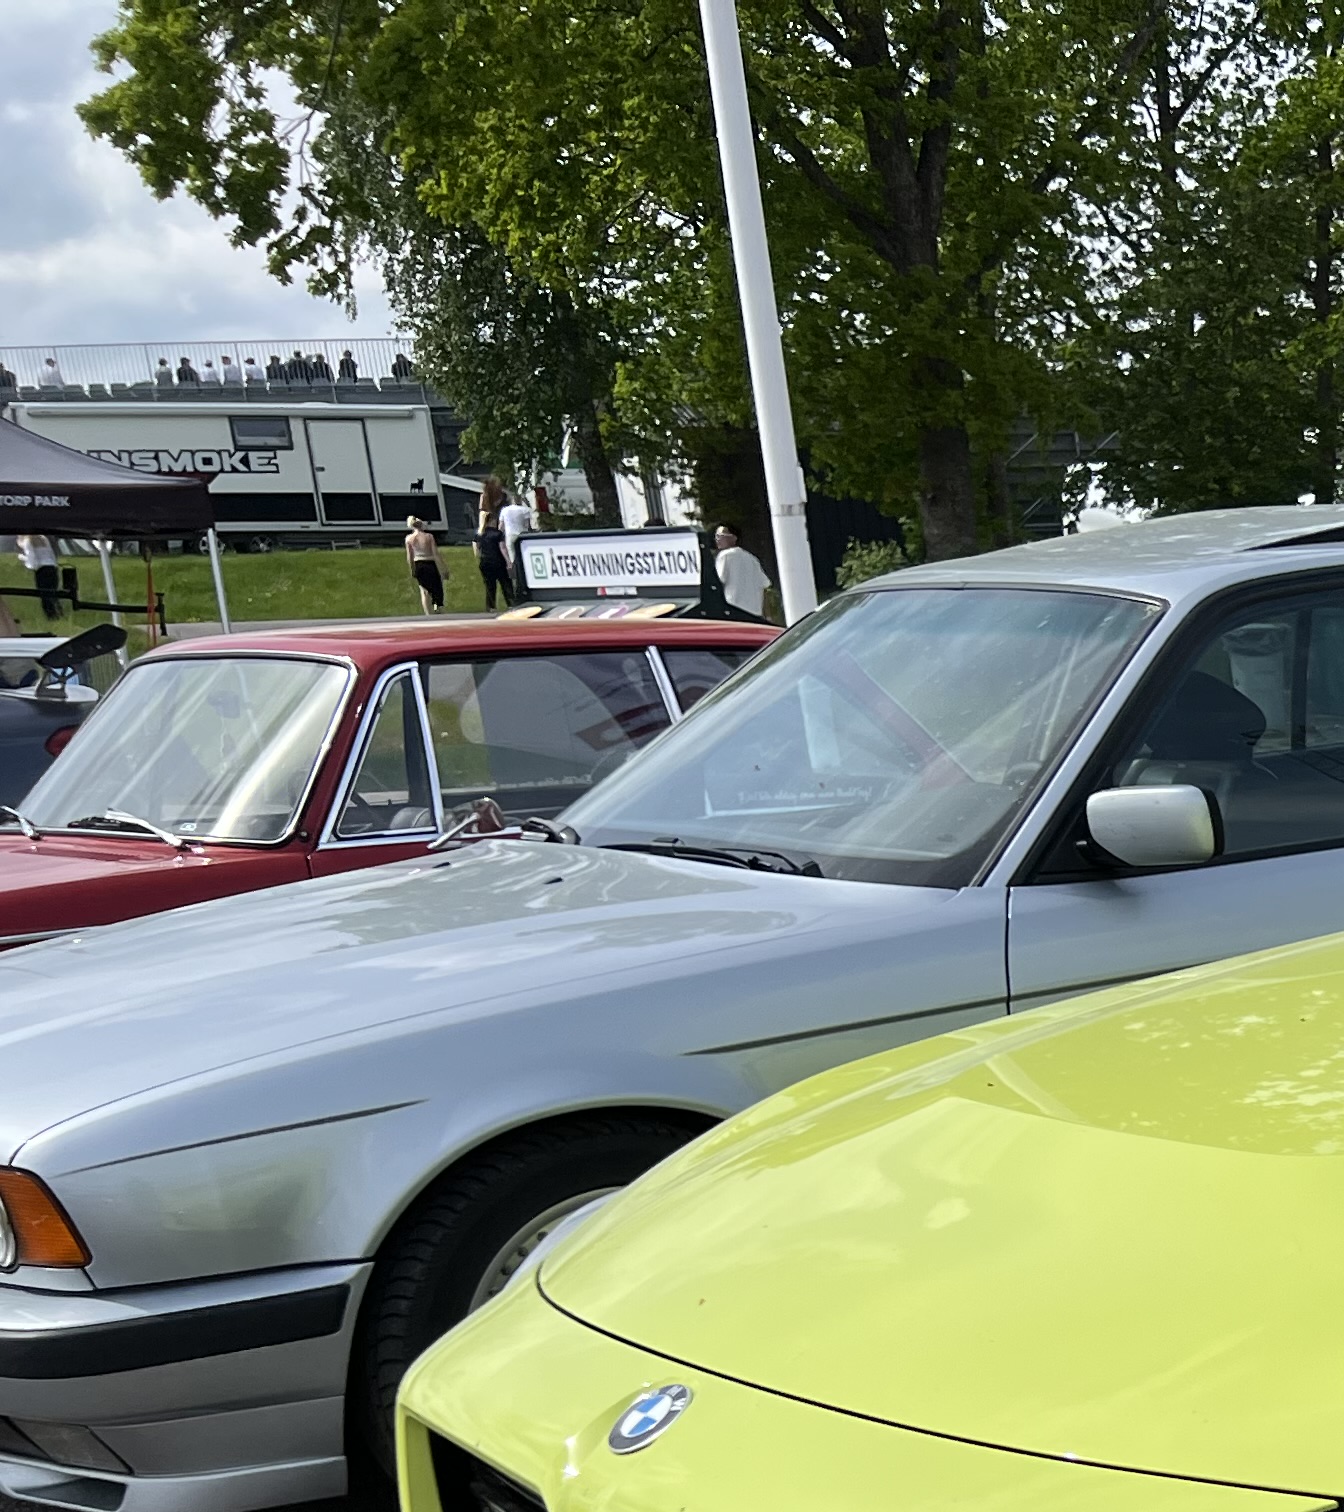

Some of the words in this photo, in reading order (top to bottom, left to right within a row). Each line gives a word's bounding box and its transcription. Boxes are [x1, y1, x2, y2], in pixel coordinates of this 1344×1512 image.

[87, 449, 279, 474] NSMOKE
[33, 495, 71, 507] PARK
[549, 548, 699, 577] ÅTERVINNINGSSTATION
